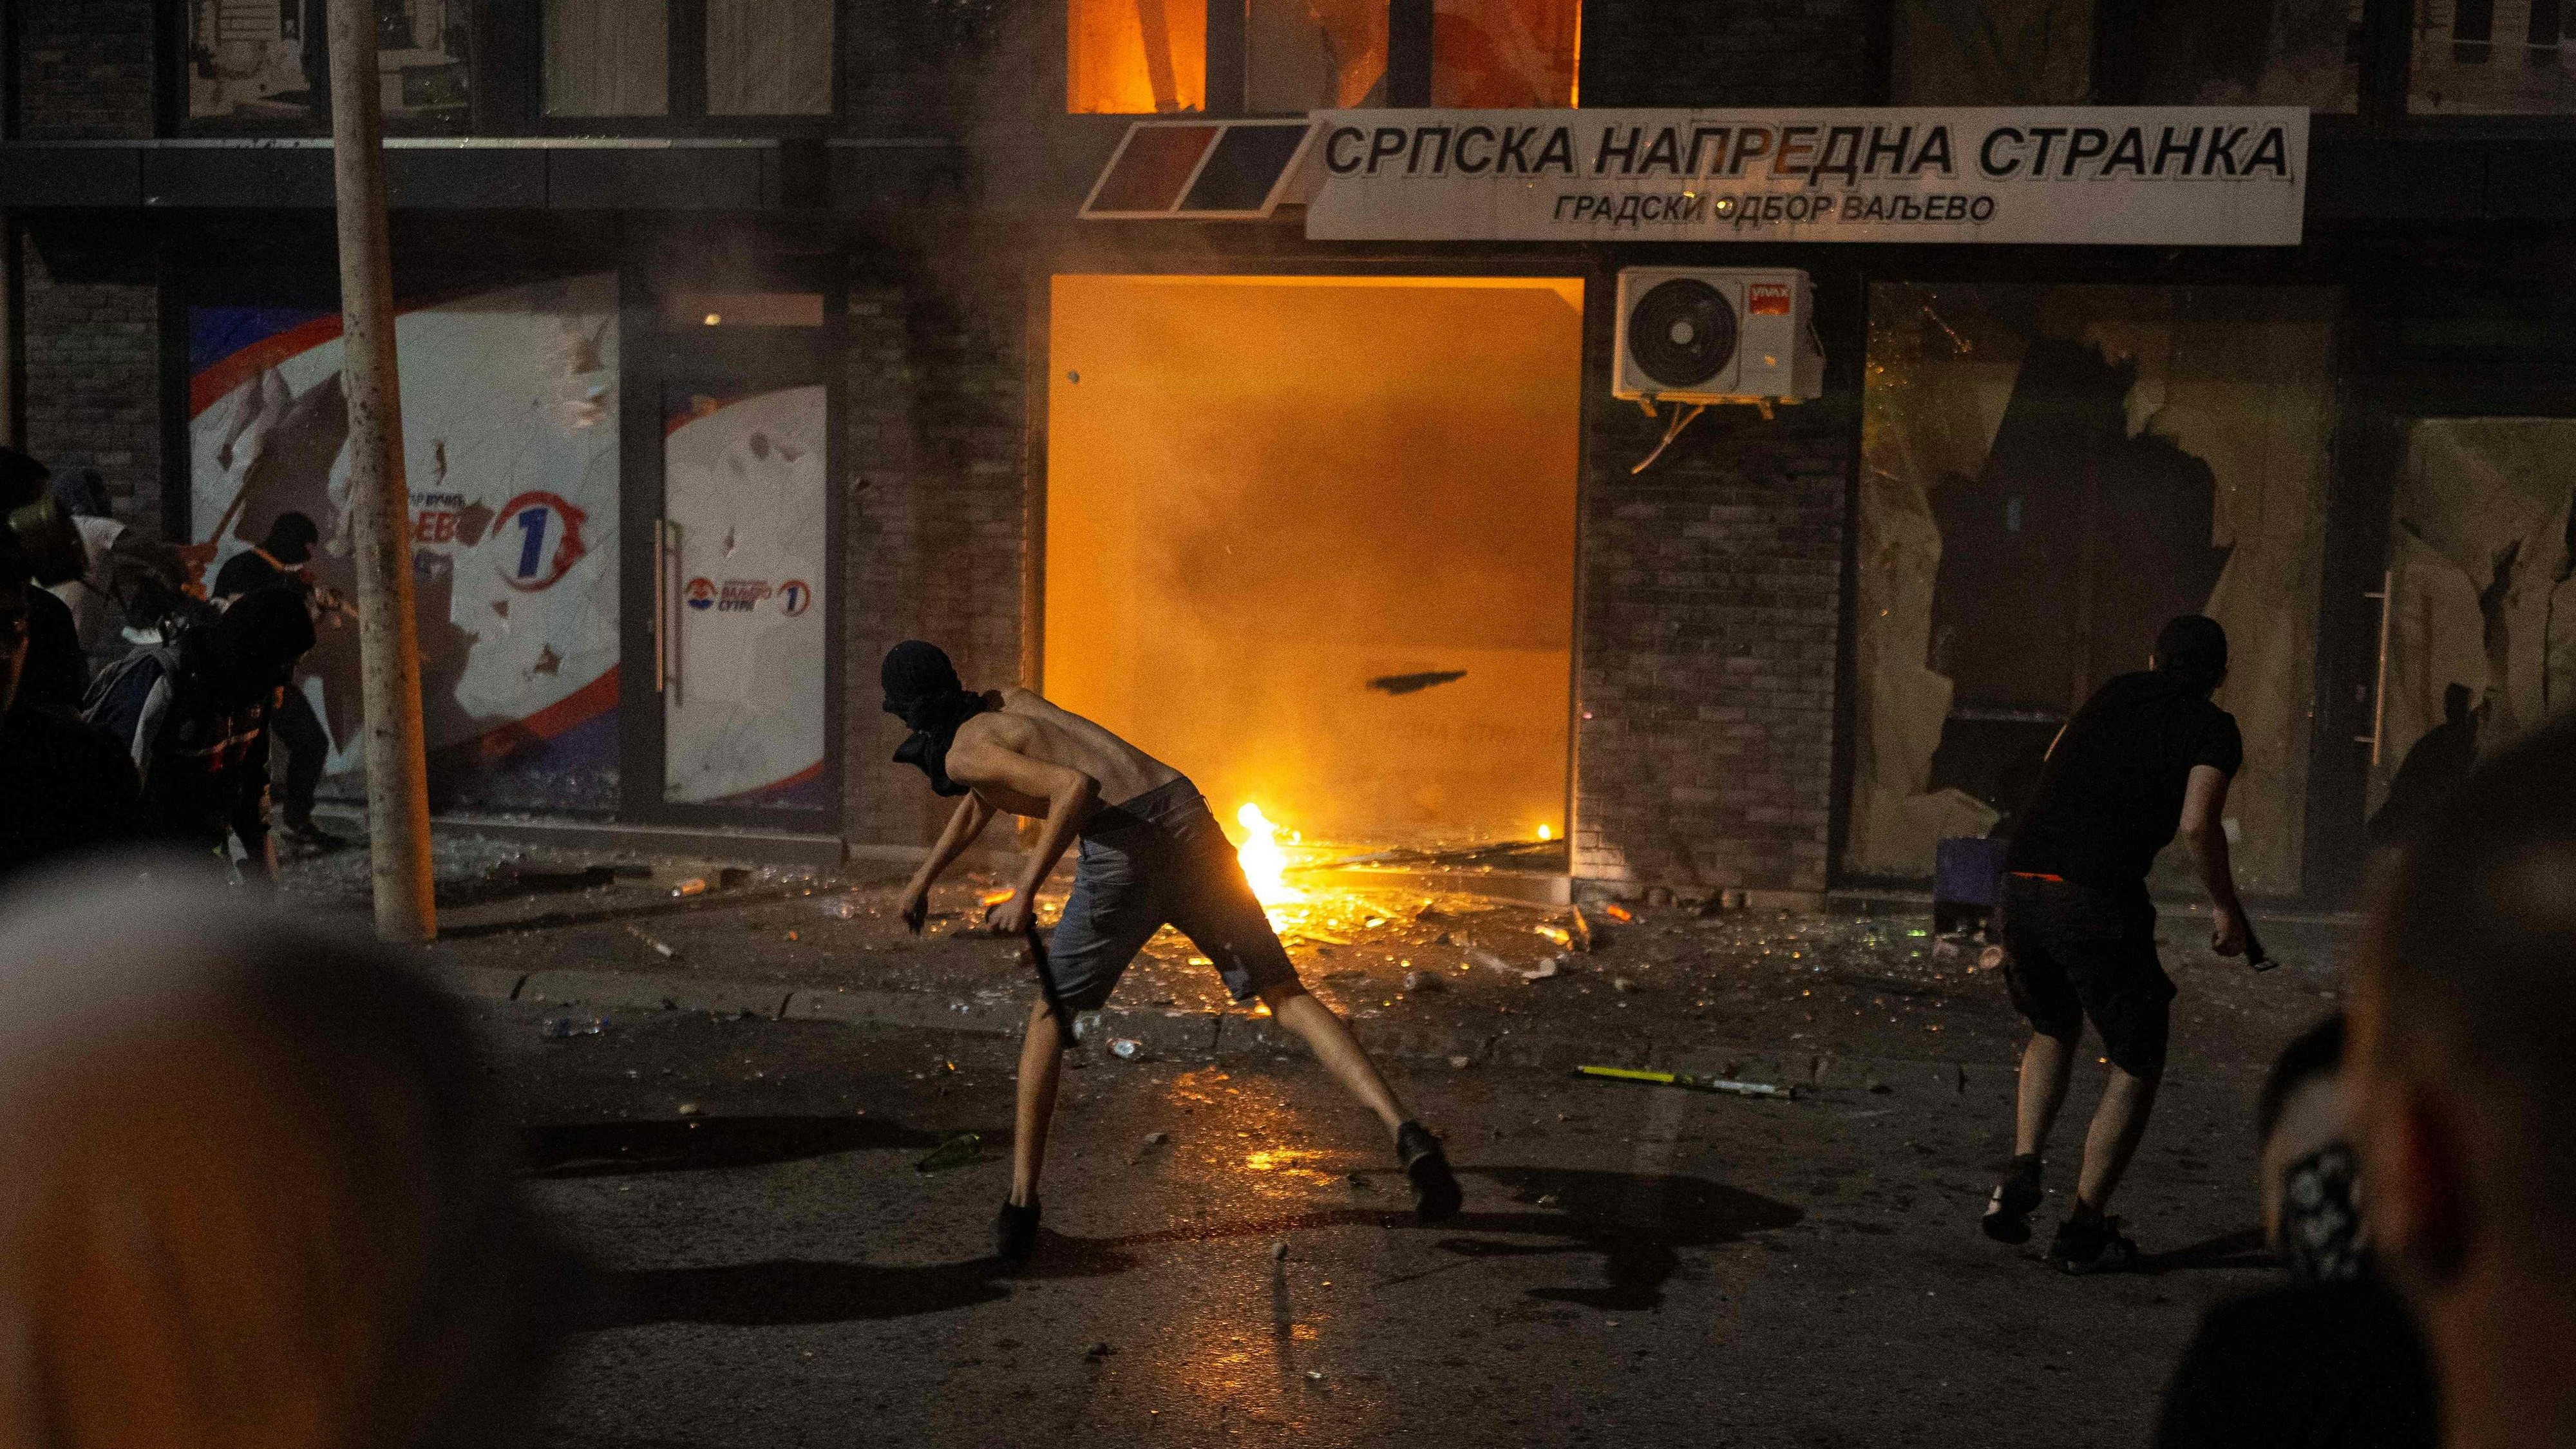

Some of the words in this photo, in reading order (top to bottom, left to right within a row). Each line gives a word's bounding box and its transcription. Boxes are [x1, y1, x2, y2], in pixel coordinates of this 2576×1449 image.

[1325, 126, 1574, 175] СРПСКА
[1594, 126, 1953, 187] НАПРЕДНА
[1980, 126, 2287, 176] СТРАНКА
[1553, 195, 1709, 228] ГРАДСКИ
[1716, 195, 1835, 228] ОДБОР
[1842, 195, 1996, 222] ВАЉЕВО
[517, 507, 548, 578] 1
[786, 586, 799, 611] 1
